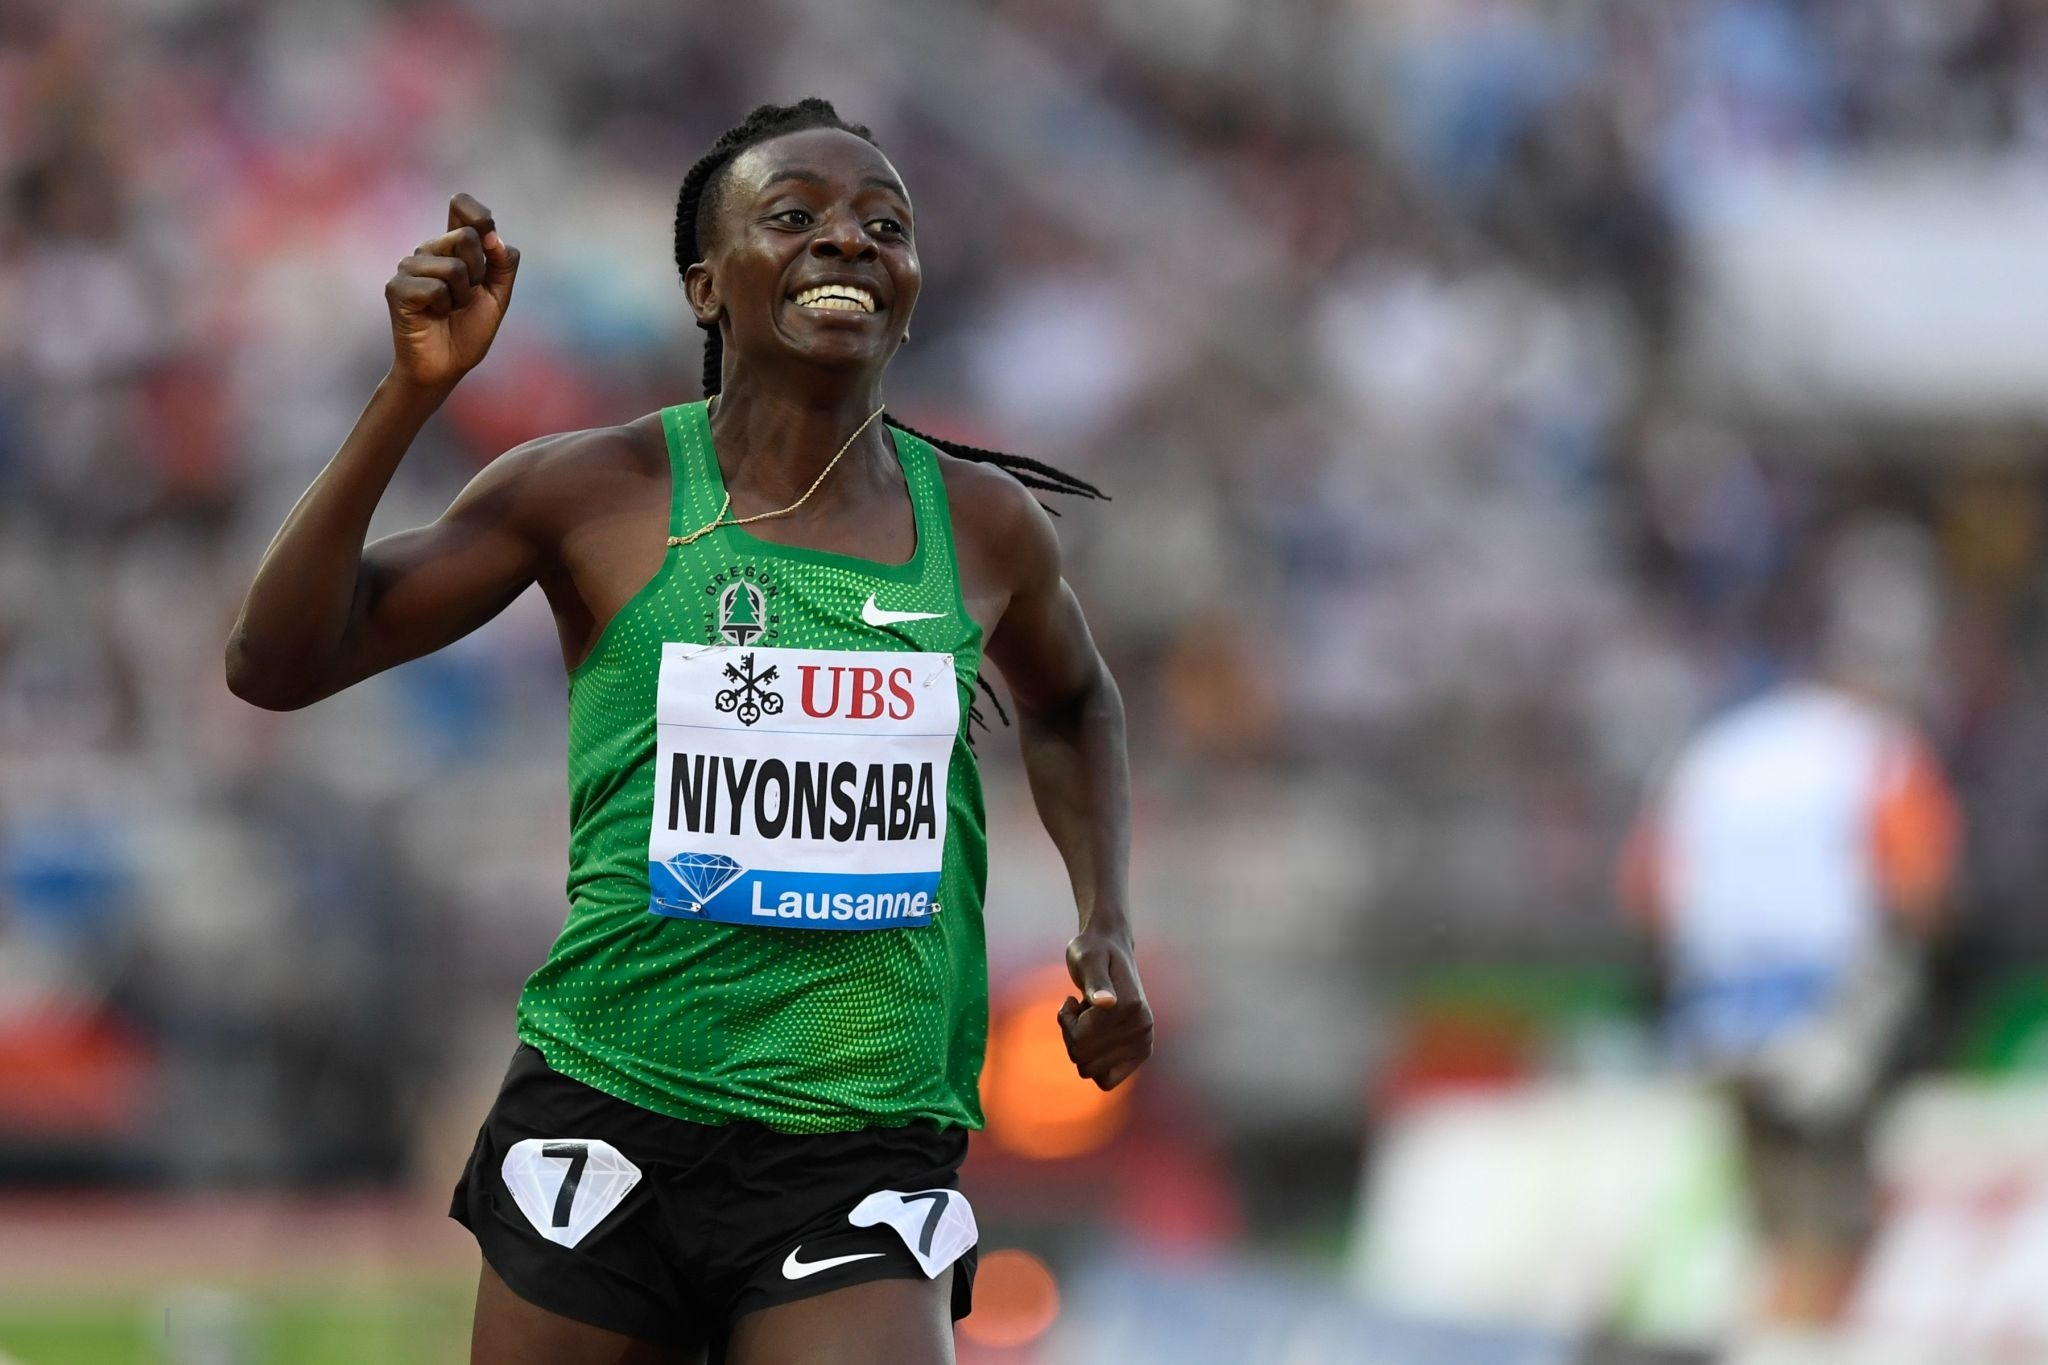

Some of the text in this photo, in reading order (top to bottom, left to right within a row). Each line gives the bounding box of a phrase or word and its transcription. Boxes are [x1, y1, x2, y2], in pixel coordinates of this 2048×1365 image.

[705, 566, 779, 598] OREGON
[704, 612, 717, 646] TRA
[797, 665, 915, 721] UBS
[668, 752, 936, 842] NIYONSABA
[751, 880, 928, 921] Lausanne
[542, 1143, 589, 1228] 7
[900, 1191, 950, 1258] 7
